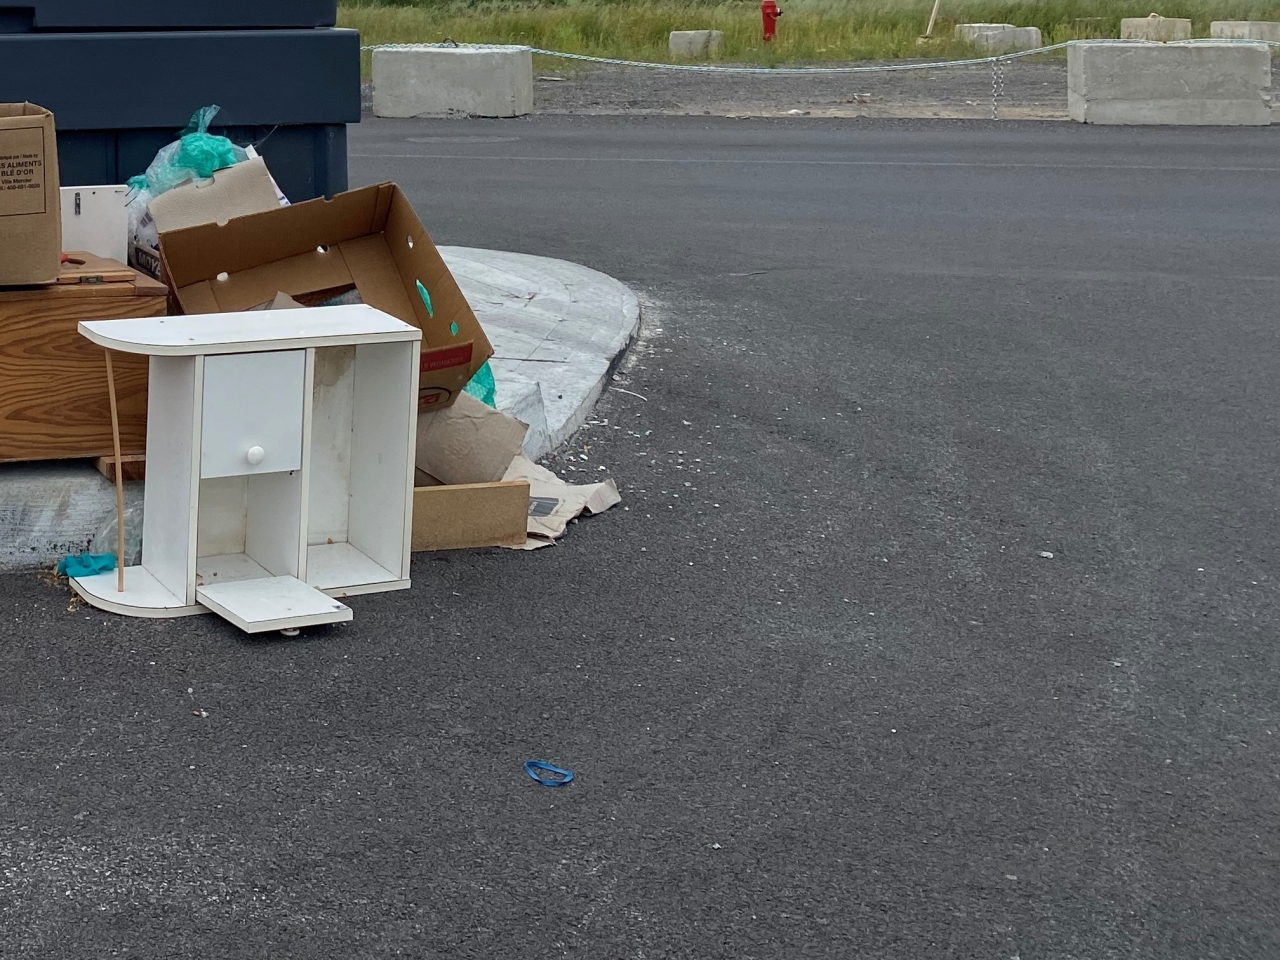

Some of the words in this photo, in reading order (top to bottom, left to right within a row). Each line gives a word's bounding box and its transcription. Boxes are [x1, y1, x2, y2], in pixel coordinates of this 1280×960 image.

[6, 160, 42, 169] ALIMENTS
[1, 168, 15, 177] BLÉ
[16, 168, 34, 176] D'OR
